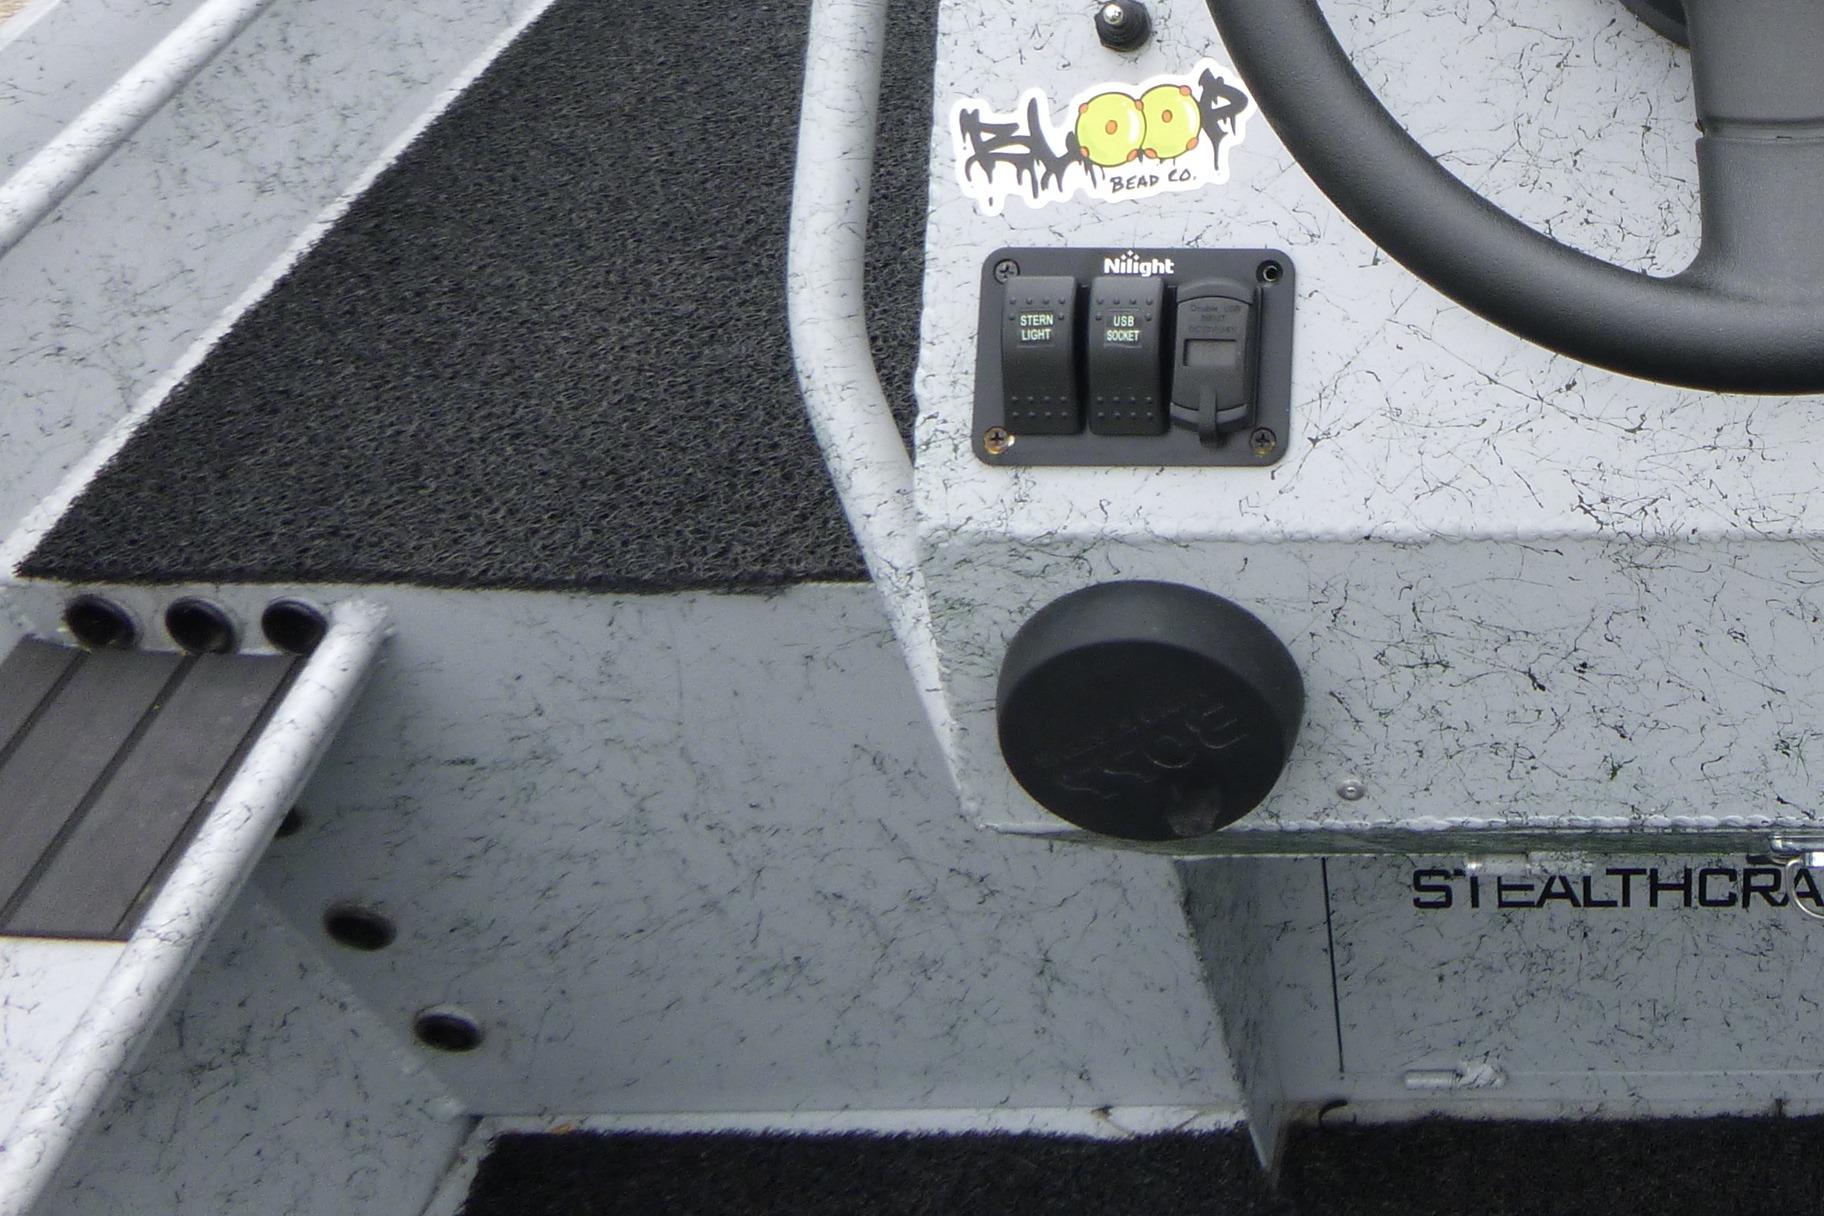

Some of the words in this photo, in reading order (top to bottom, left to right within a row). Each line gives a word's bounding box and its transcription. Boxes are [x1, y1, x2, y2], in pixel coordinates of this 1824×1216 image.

[1110, 174, 1159, 194] BEAD
[1167, 168, 1197, 183] CO.
[1103, 255, 1175, 277] Nilight
[1019, 314, 1054, 327] STERN
[1112, 315, 1135, 327] USB
[1020, 328, 1052, 341] LIGHT
[1106, 329, 1140, 342] SOCKET
